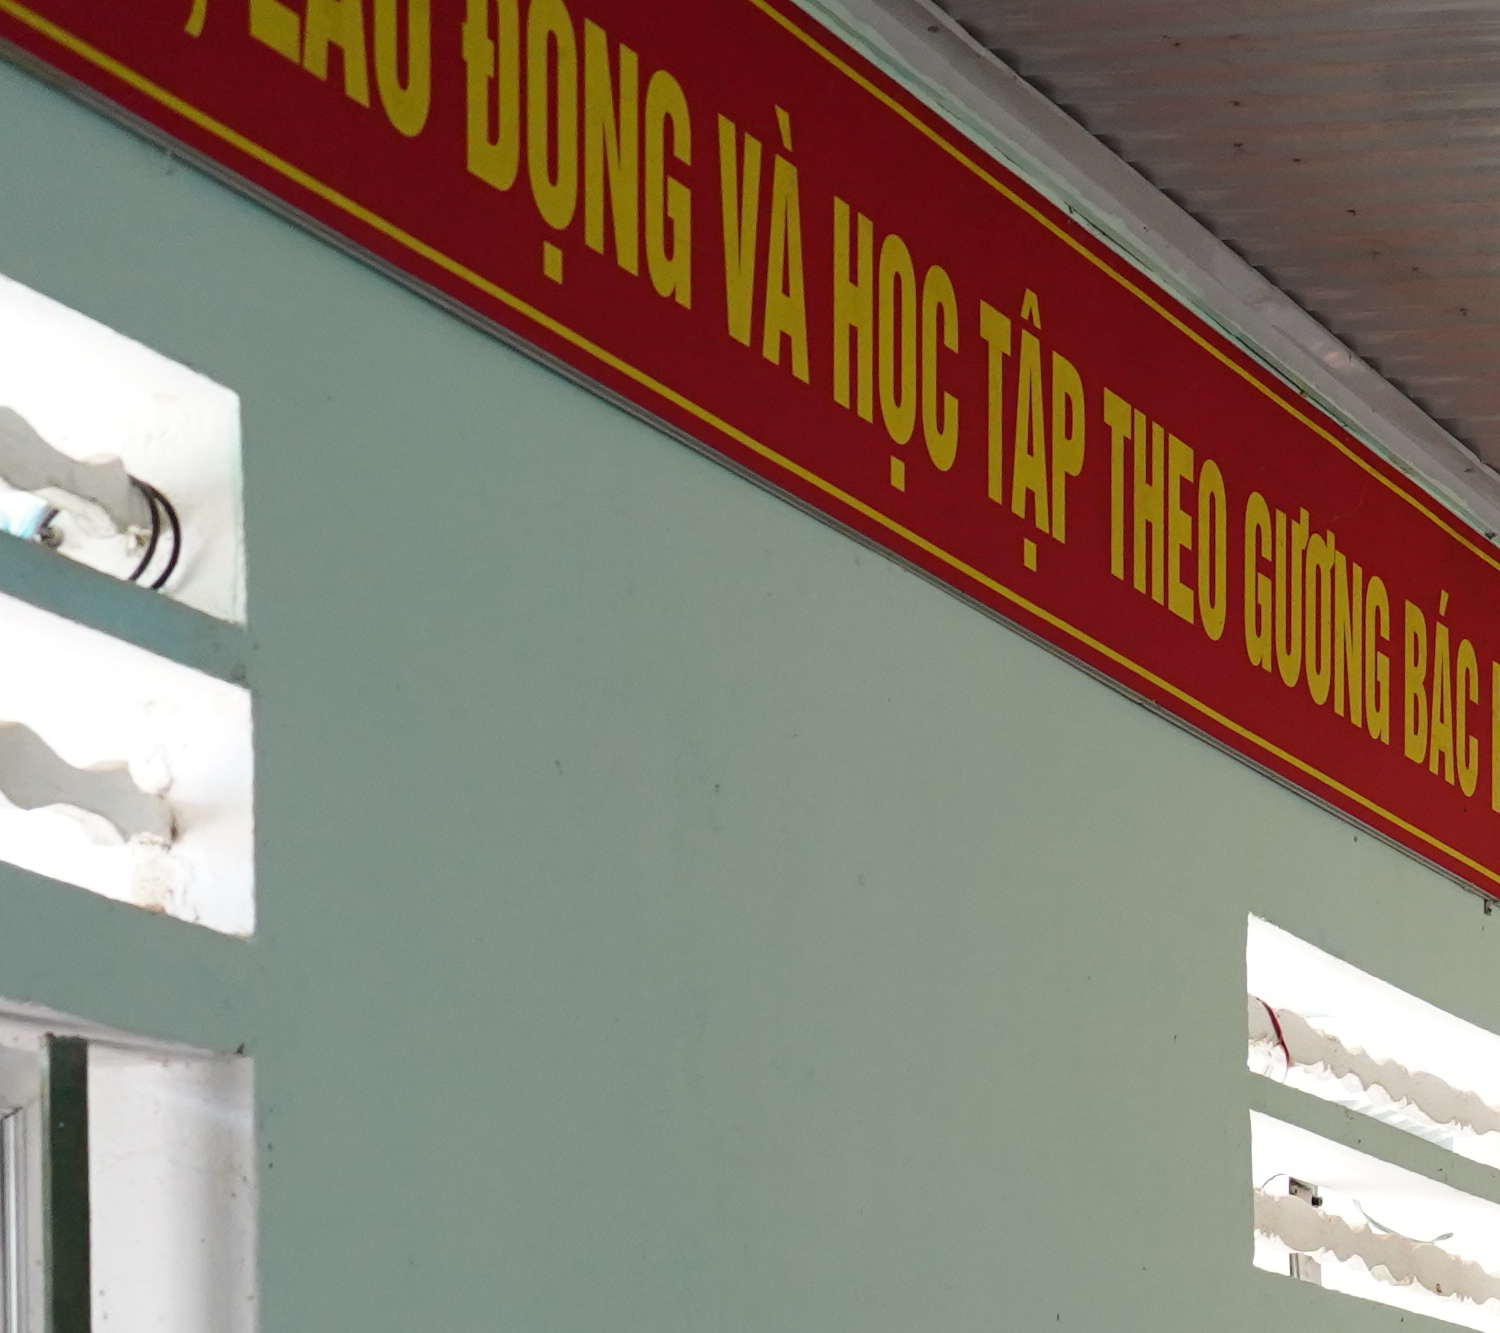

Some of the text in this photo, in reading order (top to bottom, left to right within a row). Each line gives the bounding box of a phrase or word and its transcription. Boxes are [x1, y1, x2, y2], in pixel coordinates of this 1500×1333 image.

[717, 105, 810, 385] VÀ
[833, 195, 959, 492] HỌC
[979, 288, 1086, 572] TẬP
[1103, 387, 1228, 641] THEO
[1244, 491, 1391, 745] GƯƠNG
[1404, 589, 1479, 798] BÁC
